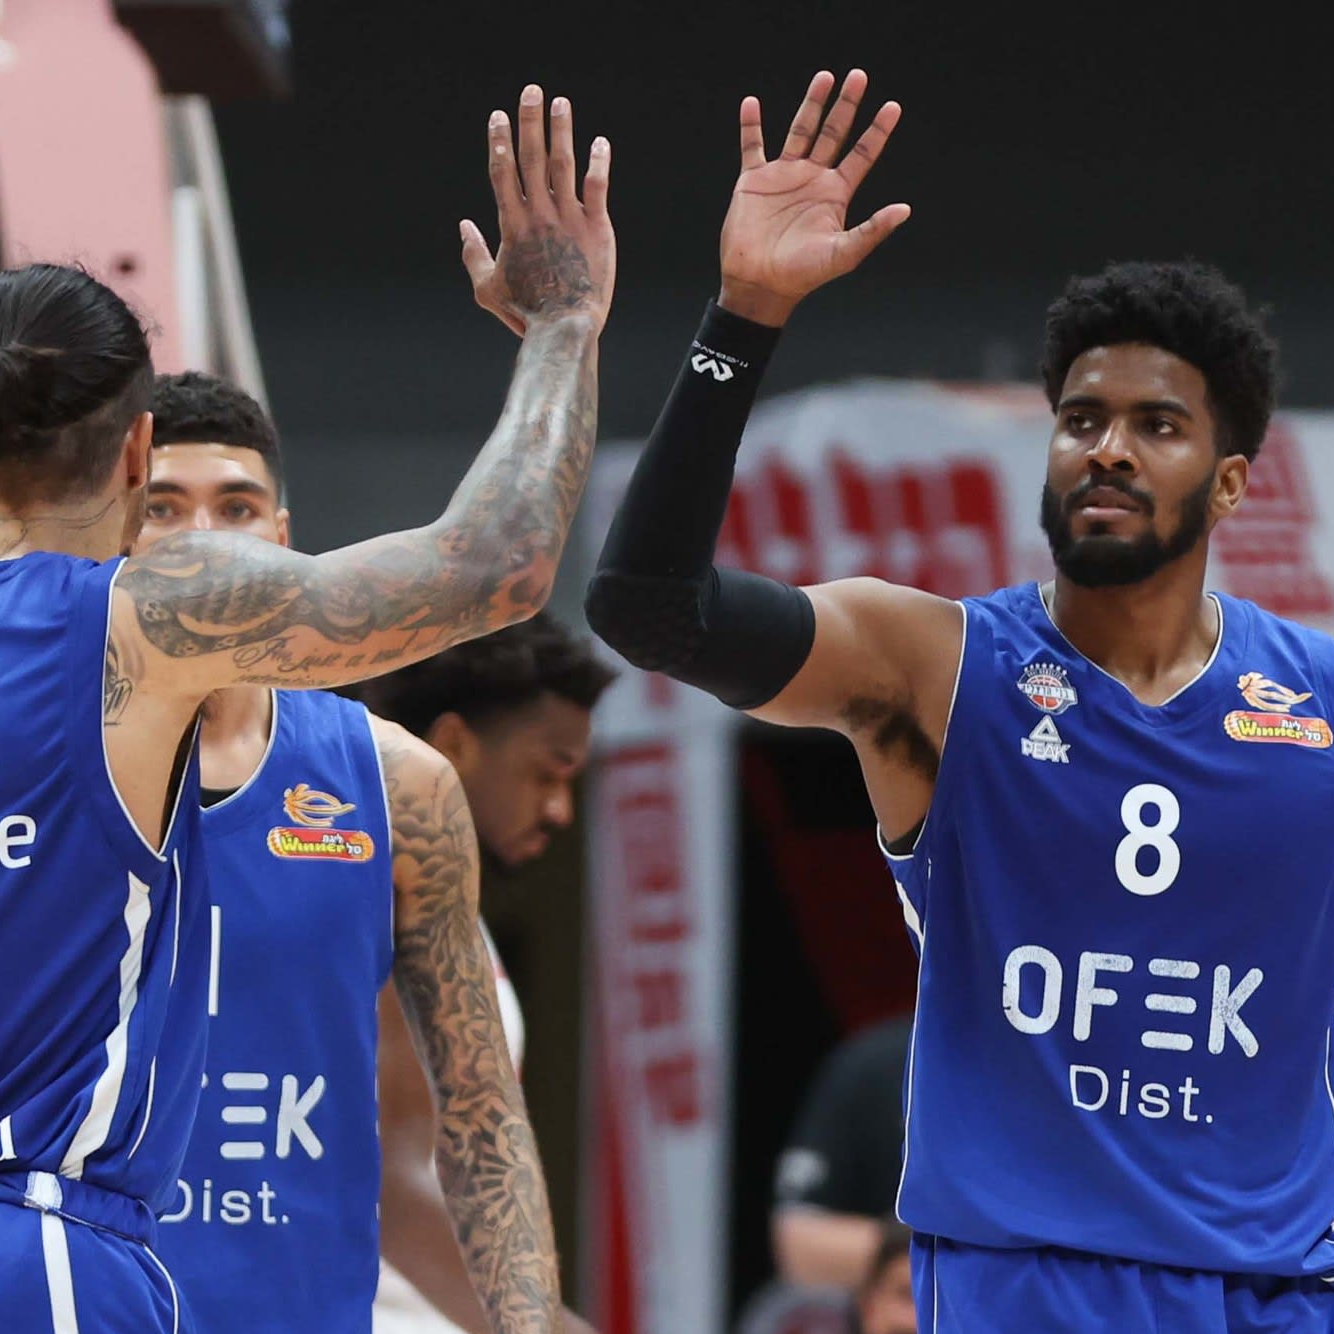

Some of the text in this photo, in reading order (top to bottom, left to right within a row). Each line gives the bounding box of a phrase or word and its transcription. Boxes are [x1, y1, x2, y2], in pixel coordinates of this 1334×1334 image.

[1020, 736, 1072, 764] PEAK
[1237, 719, 1304, 740] Winner
[280, 833, 345, 853] Winner
[1114, 782, 1182, 897] 8
[1001, 944, 1265, 1059] OFEK
[1068, 1063, 1214, 1124] Dist.
